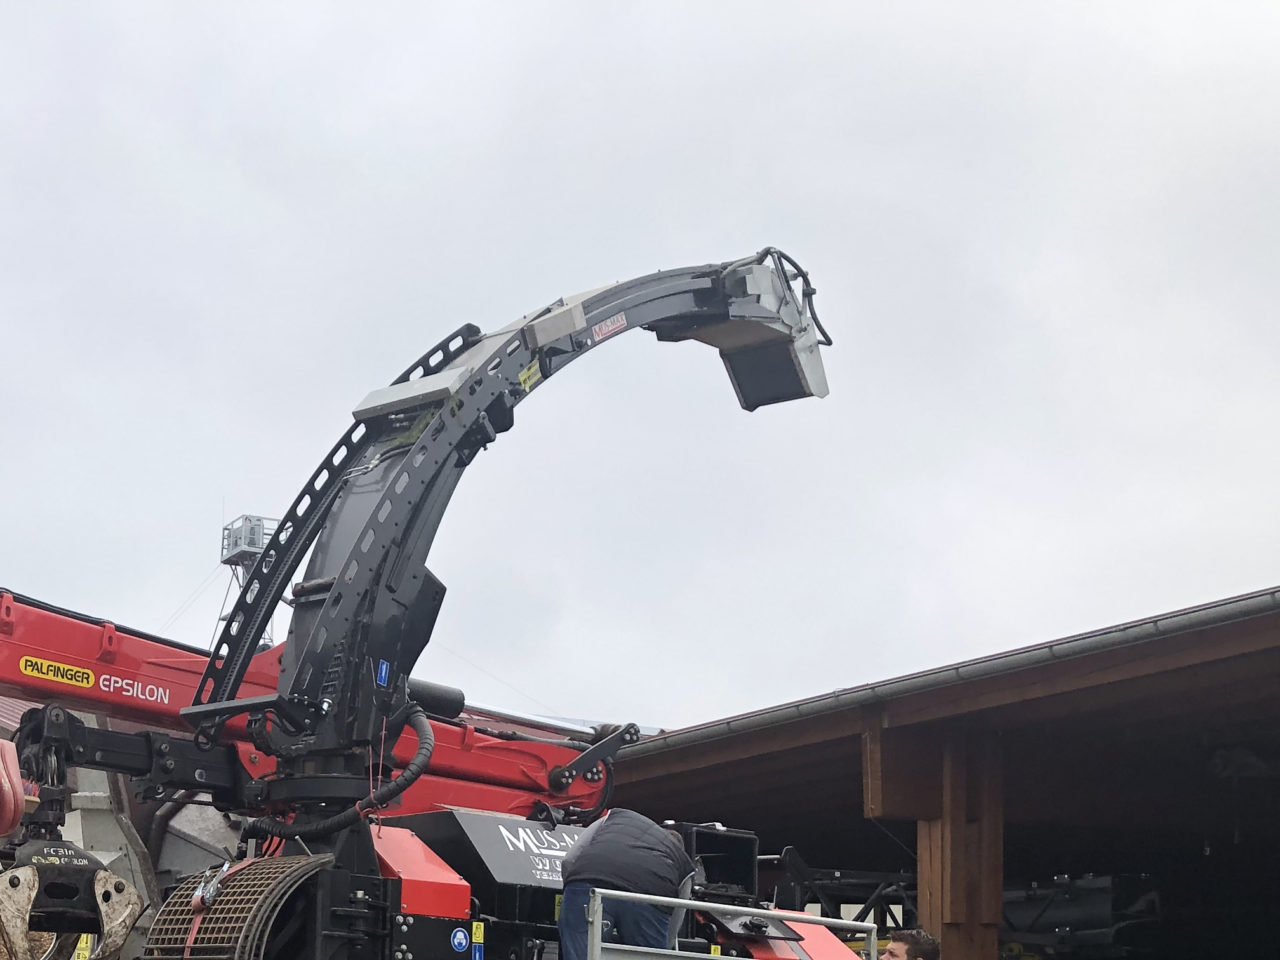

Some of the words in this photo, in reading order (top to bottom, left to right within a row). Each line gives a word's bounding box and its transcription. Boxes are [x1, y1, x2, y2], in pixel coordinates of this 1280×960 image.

[23, 658, 91, 685] PALFINGER
[99, 674, 170, 704] EPSILON
[498, 824, 579, 854] MUS-M
